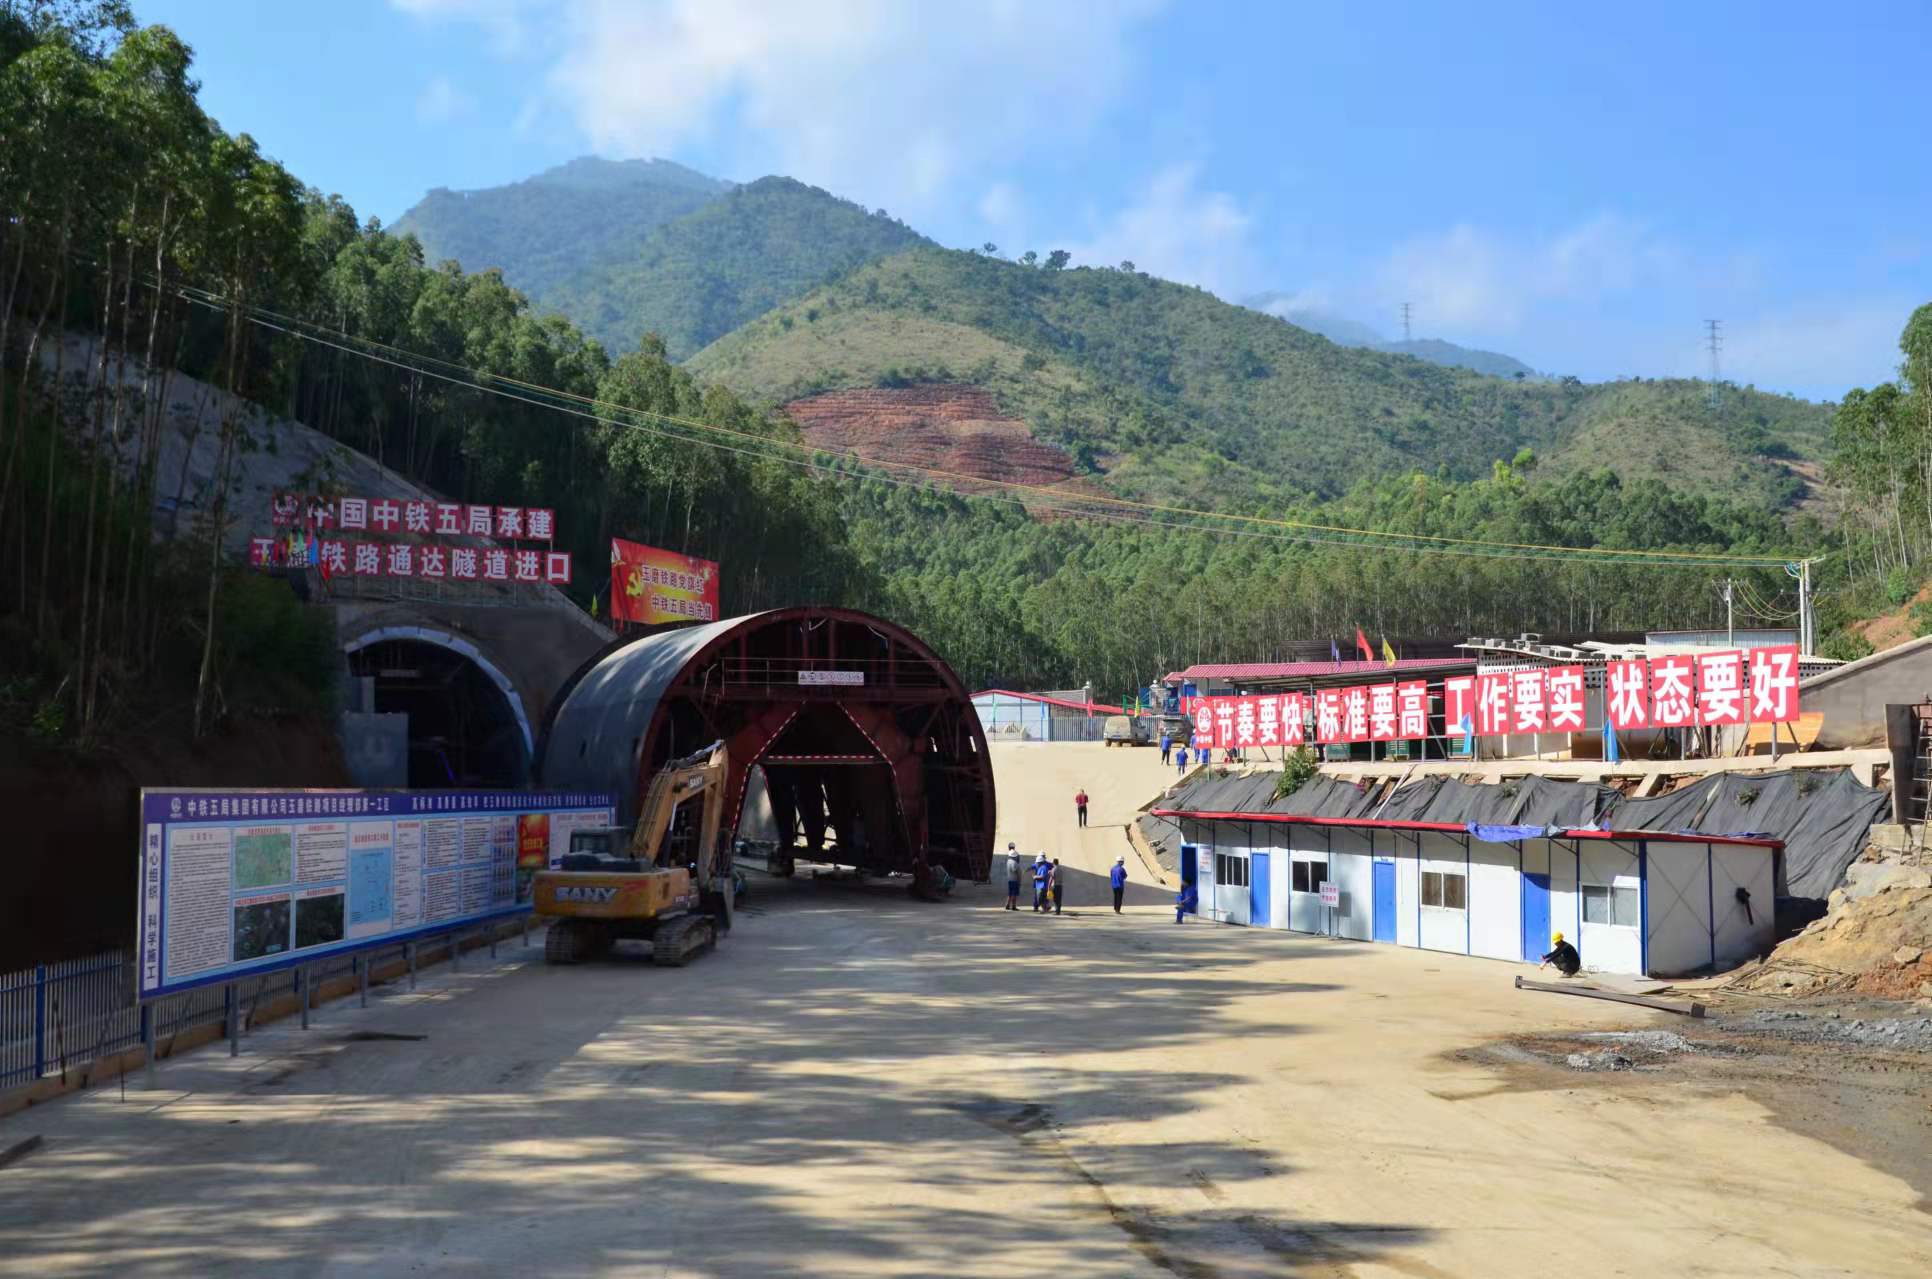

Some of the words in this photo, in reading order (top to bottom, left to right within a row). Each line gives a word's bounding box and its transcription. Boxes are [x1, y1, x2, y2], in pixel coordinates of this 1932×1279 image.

[1216, 691, 1302, 747] 节奏要快
[1318, 684, 1425, 741] 标准要高
[1446, 668, 1583, 737] 工作要实
[1609, 652, 1796, 728] 状态要好
[555, 887, 617, 903] SANY
